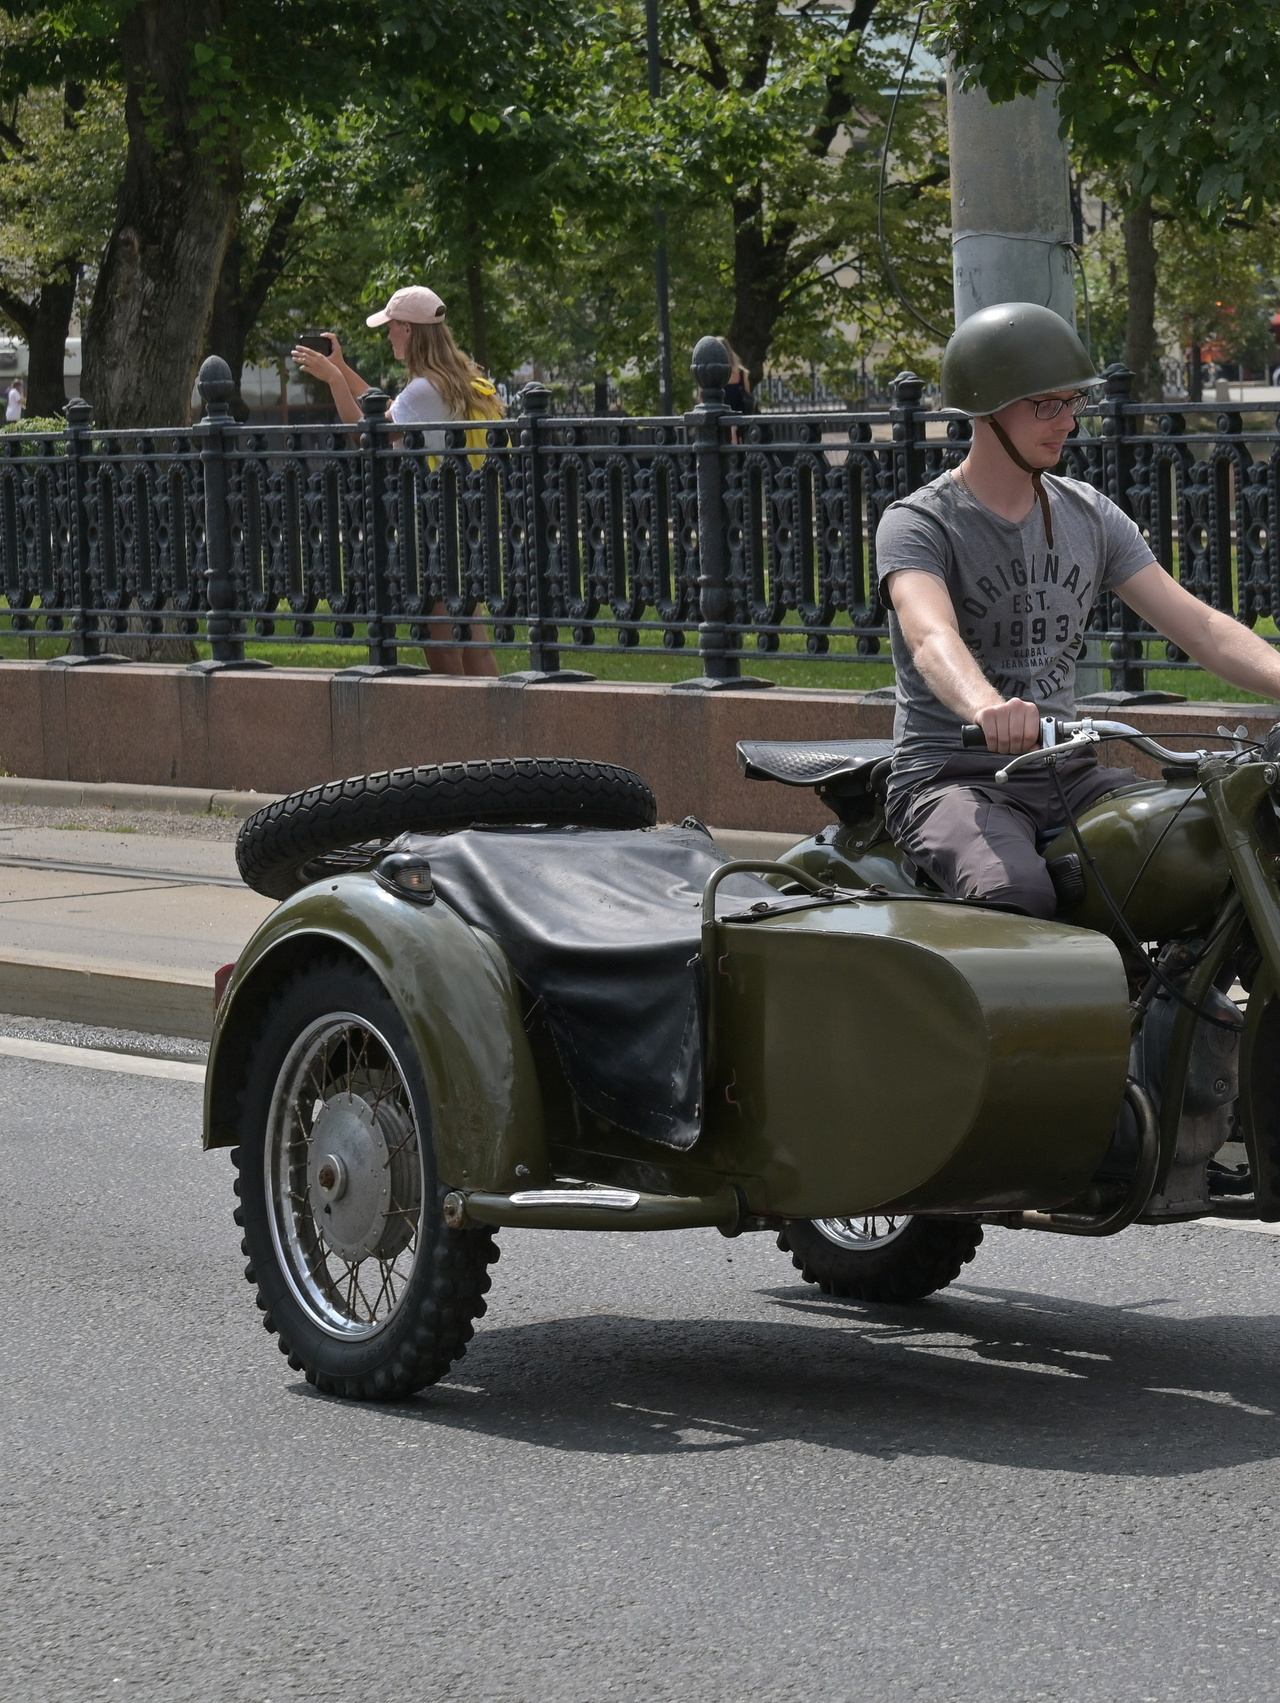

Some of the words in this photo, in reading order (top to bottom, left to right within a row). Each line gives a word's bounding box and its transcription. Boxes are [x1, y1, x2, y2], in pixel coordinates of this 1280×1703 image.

[962, 553, 1091, 619] ORIGINAL
[1013, 590, 1050, 614] EST.
[993, 614, 1069, 648] 1993
[965, 638, 1026, 697] BND
[1036, 632, 1083, 699] DENIM
[1014, 646, 1047, 658] GLOBAL
